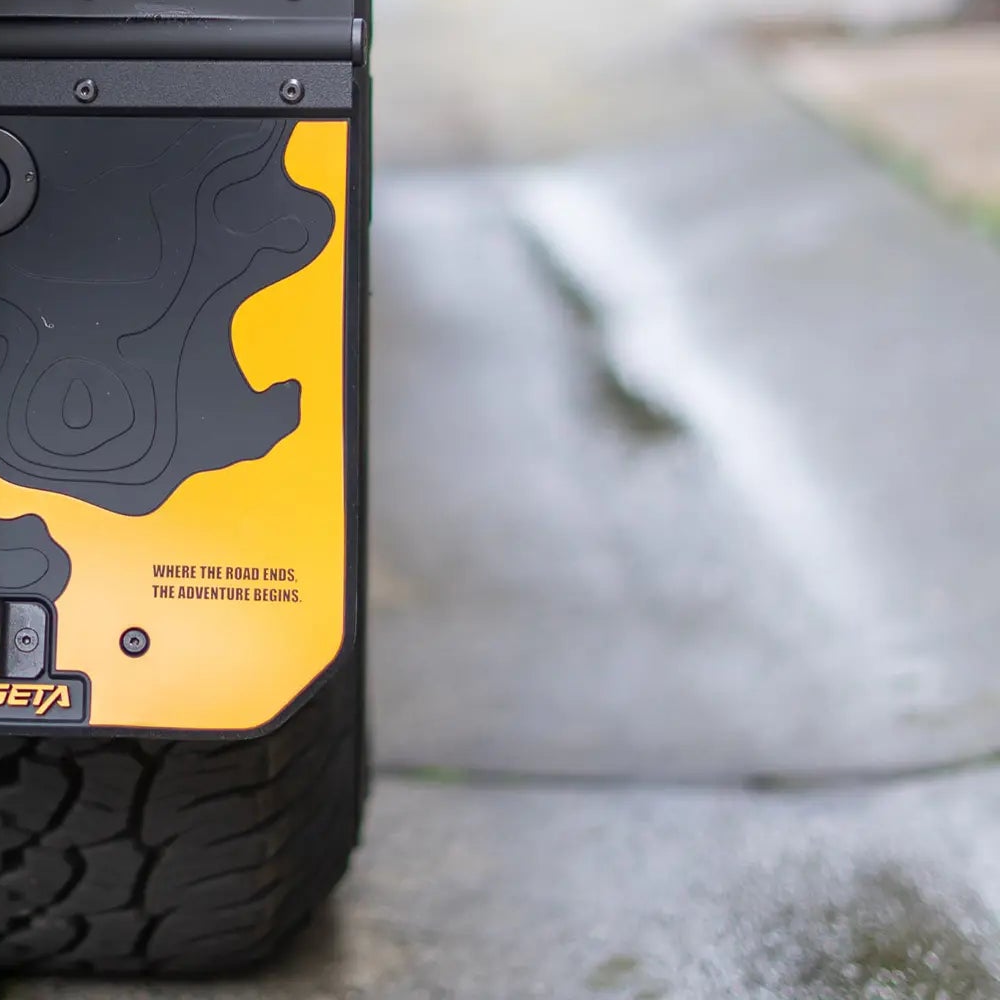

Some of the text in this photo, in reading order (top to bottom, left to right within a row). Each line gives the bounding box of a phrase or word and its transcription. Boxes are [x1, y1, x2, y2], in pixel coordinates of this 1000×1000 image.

[152, 564, 197, 579] WHERE
[200, 565, 222, 580] THE
[225, 566, 260, 581] ROAD
[152, 584, 302, 603] THE ADVENTURE BEGINS.
